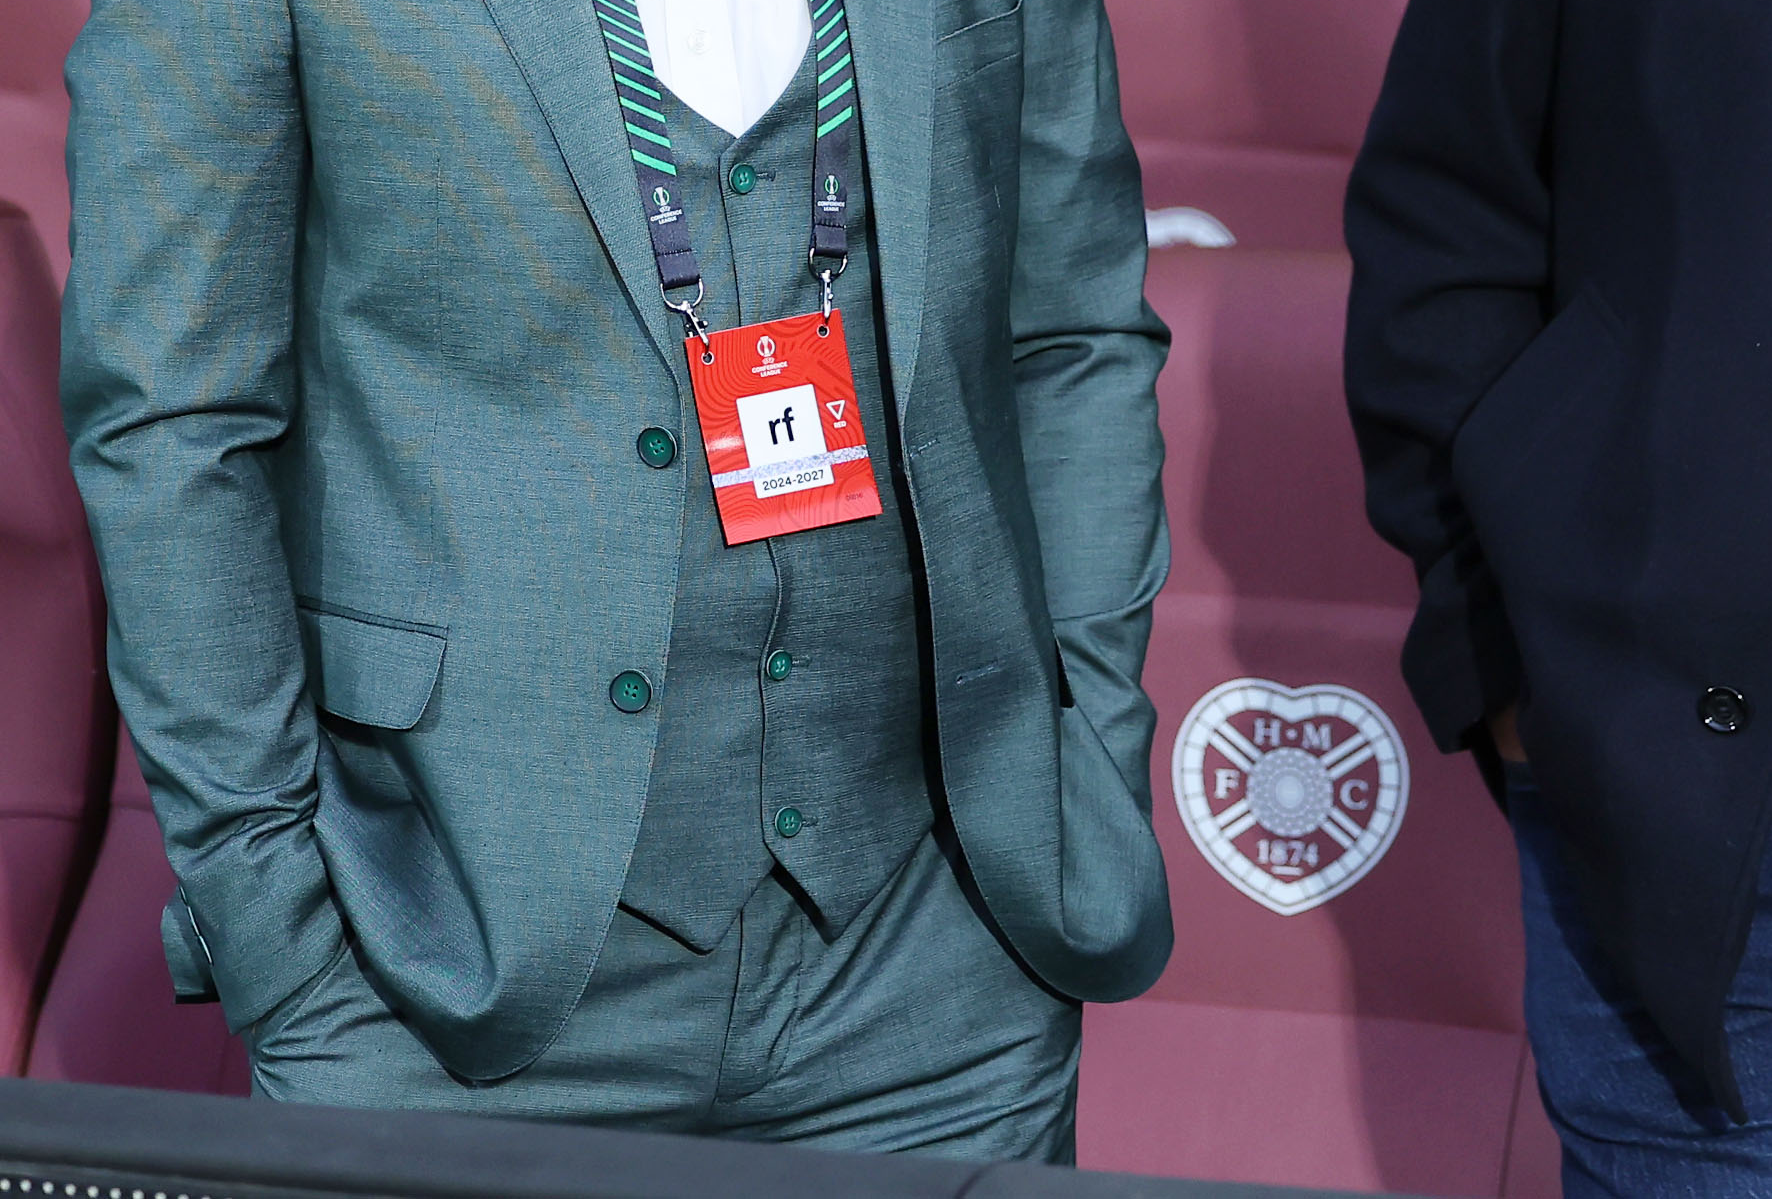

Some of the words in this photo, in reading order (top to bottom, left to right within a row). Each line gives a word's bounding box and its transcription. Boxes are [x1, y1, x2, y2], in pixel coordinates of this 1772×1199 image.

[751, 360, 789, 374] CONFERENCE
[760, 368, 781, 378] LEAGUE
[768, 406, 795, 445] rf
[762, 469, 824, 491] 2024-2027
[1213, 768, 1241, 800] F
[1339, 778, 1370, 811] C
[1255, 838, 1320, 868] 1874
